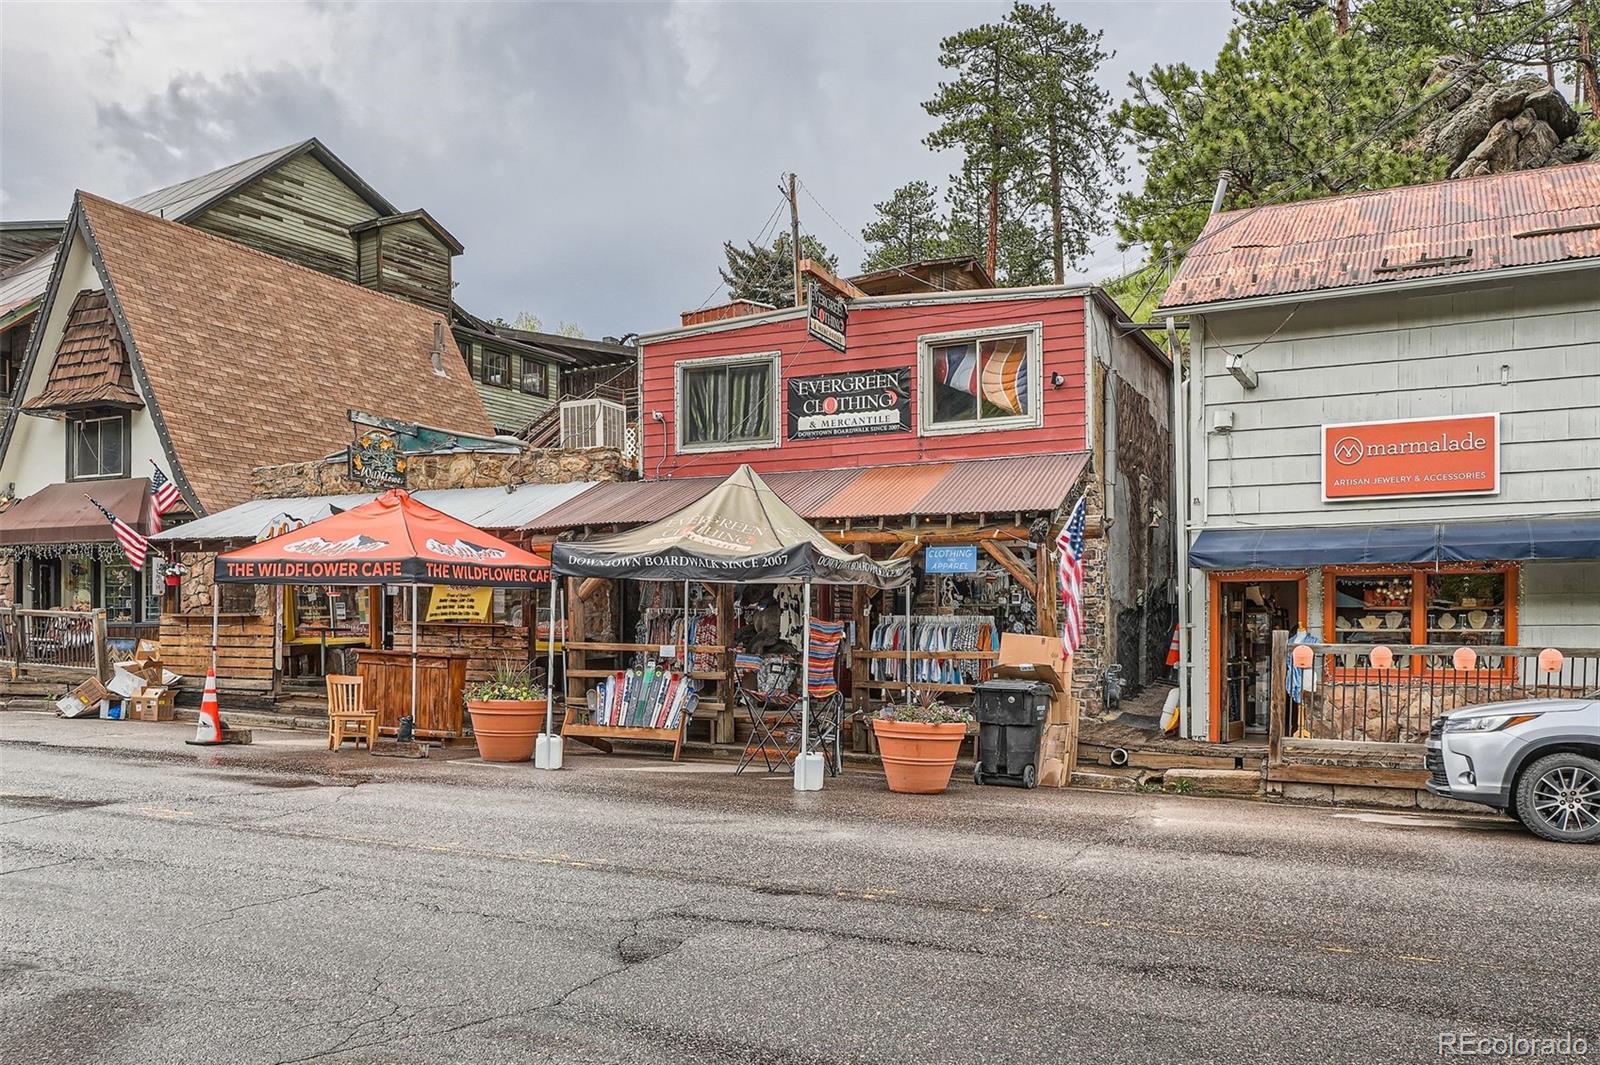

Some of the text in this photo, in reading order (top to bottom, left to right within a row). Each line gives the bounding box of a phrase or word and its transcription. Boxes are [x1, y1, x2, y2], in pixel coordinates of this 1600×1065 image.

[798, 373, 900, 396] EVERGREEN
[803, 390, 898, 415] CLOTHING
[809, 415, 891, 429] & MERCANTILE
[797, 429, 833, 438] DOWNTOWN
[833, 426, 870, 435] BOARDWALK
[870, 424, 888, 432] SINCE
[1367, 432, 1487, 457] marmalade
[1333, 471, 1486, 487] ARTISAN JEWELRY & ACCESSORIES
[568, 554, 789, 570] DOWNTOWN BOARDWALK SINCE 2007
[928, 550, 973, 558] CLOTHING
[227, 562, 402, 577] THE WILDFLOWER CAFE
[426, 563, 450, 578] THE
[452, 565, 527, 582] WILDFLOWER
[931, 562, 969, 570] APPAREL
